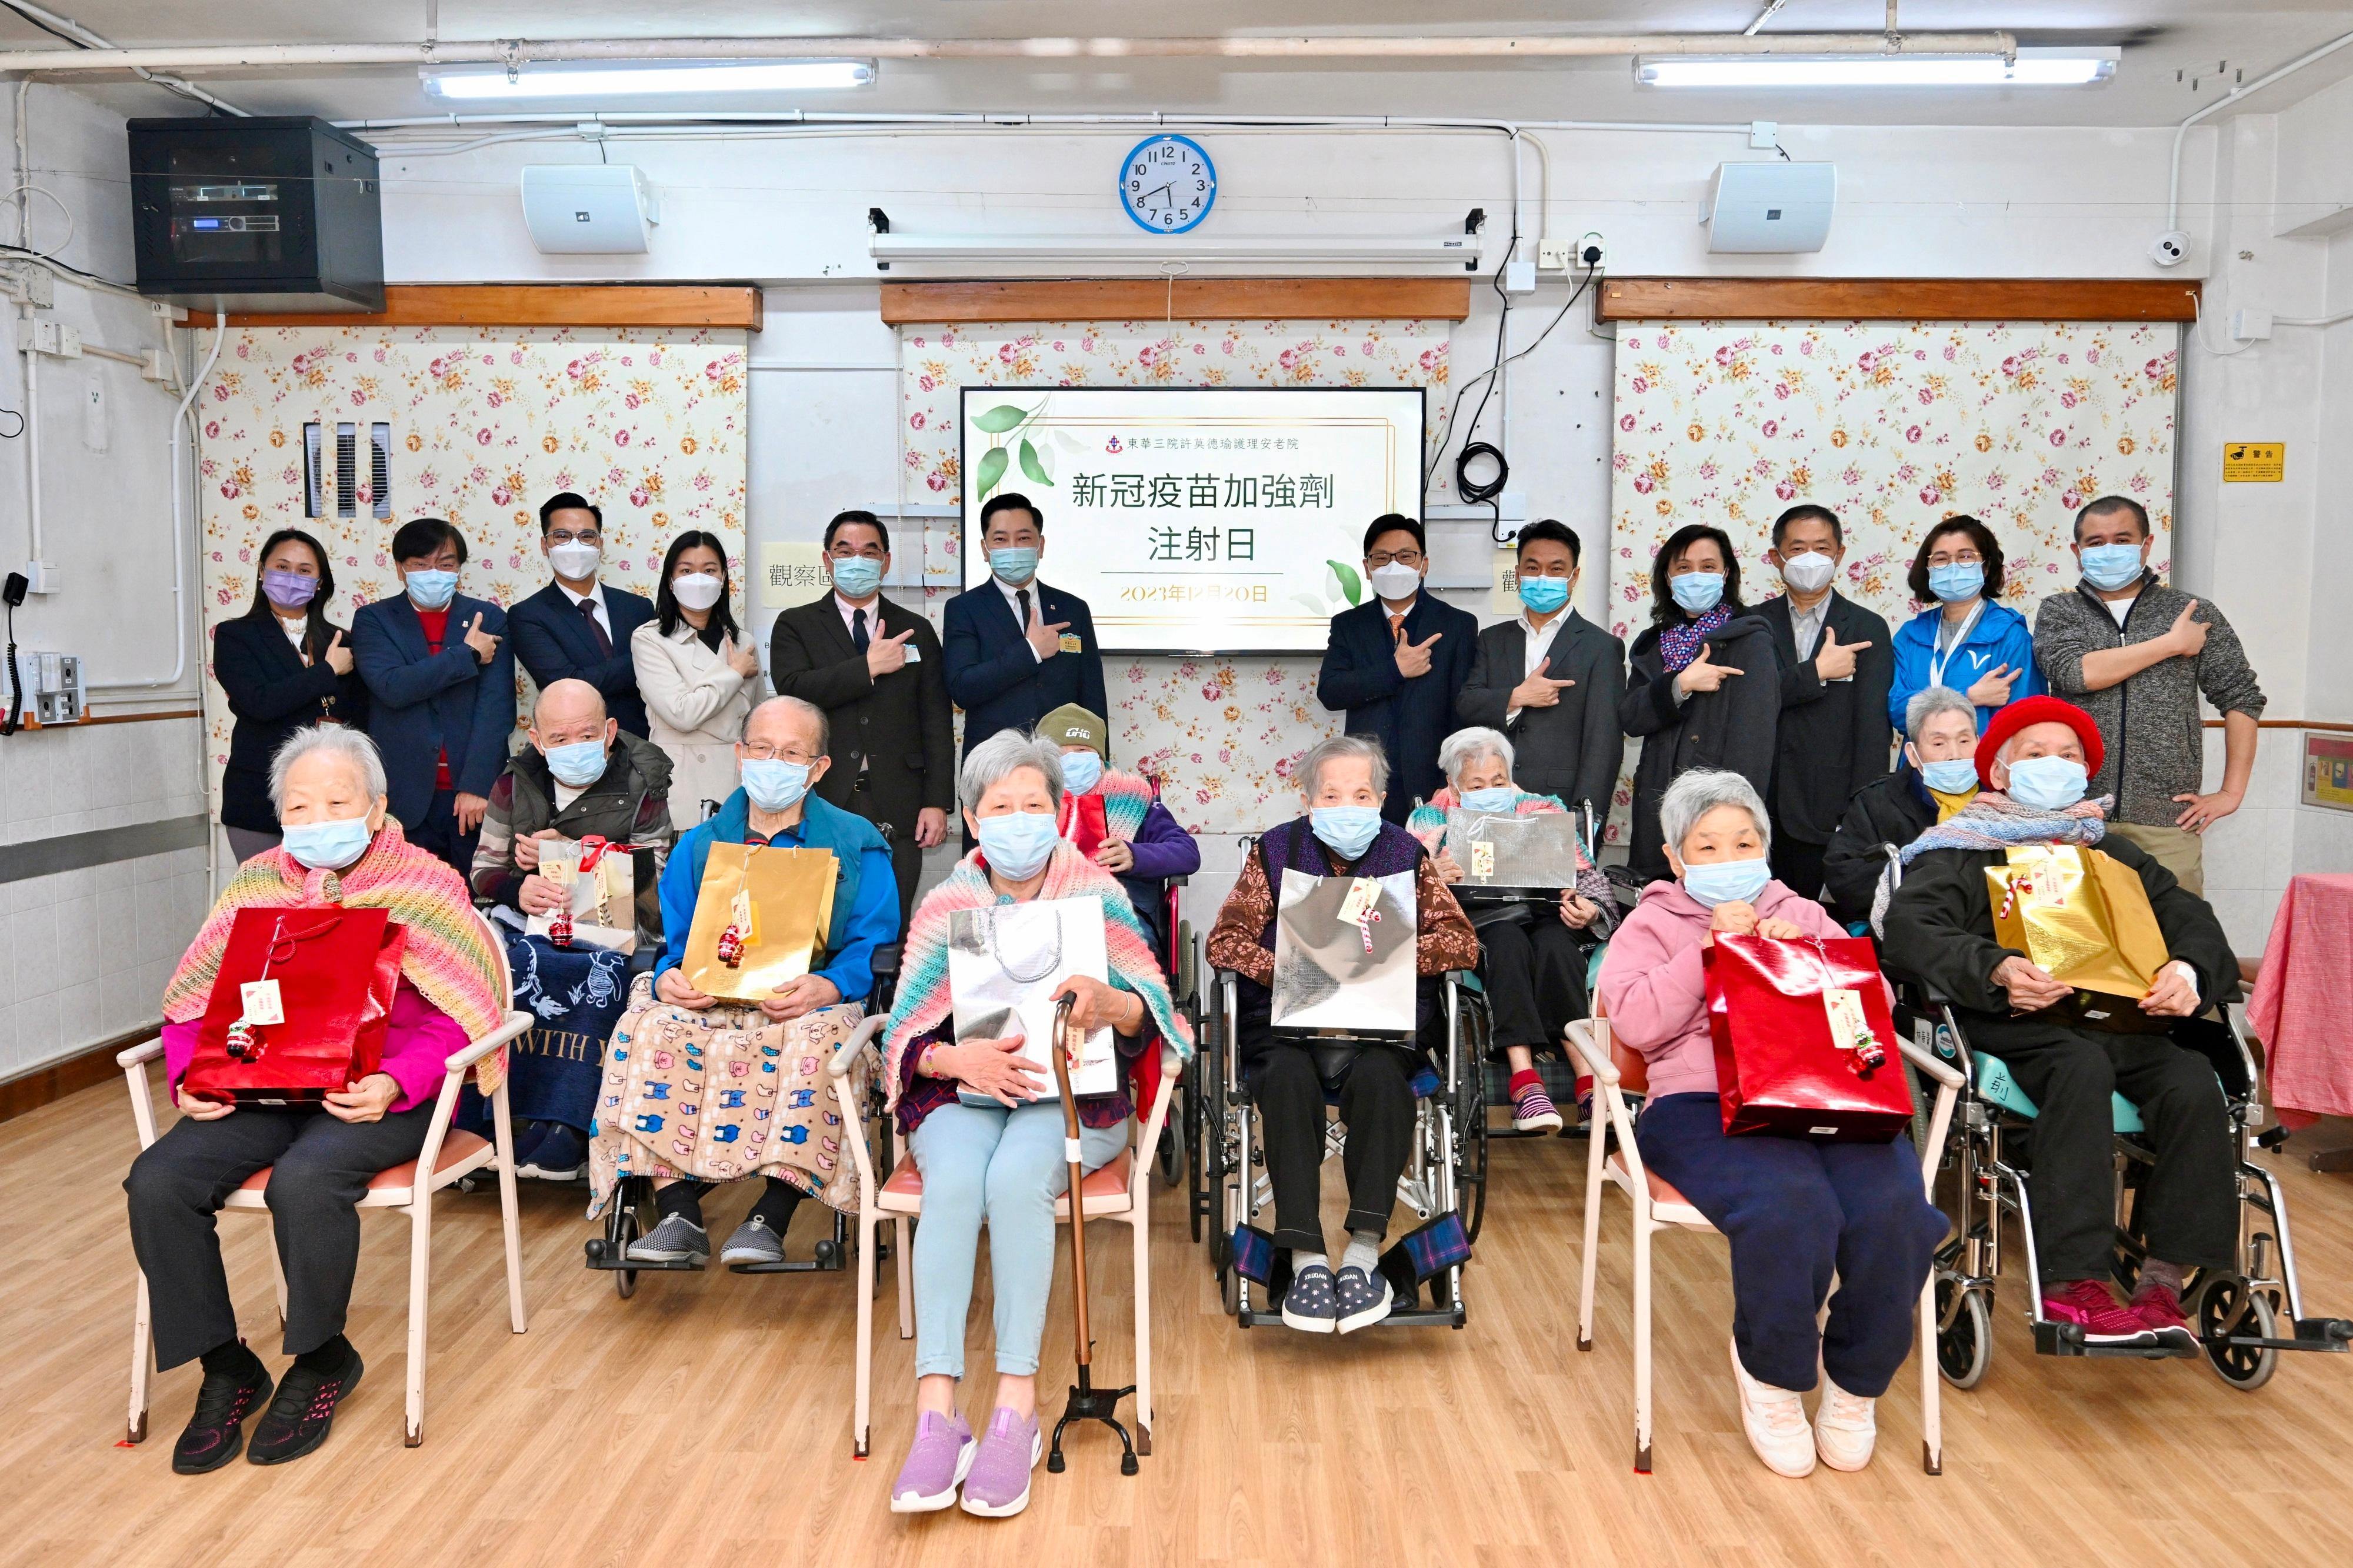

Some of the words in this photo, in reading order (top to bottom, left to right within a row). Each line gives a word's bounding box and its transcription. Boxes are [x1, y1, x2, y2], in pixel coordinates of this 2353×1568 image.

[1148, 151, 1157, 163] 11
[1162, 146, 1174, 158] 12
[1182, 151, 1185, 162] 1
[1135, 164, 1146, 175] 10
[1191, 164, 1201, 175] 2
[1131, 180, 1140, 192] 9
[1197, 179, 1205, 191] 3
[1136, 196, 1145, 208] 8
[1191, 196, 1201, 208] 4
[1149, 209, 1157, 221] 7
[1164, 213, 1173, 225] 6
[1179, 209, 1188, 220] 5
[1126, 437, 1299, 450] 東華三院許莫德瑜護理安老院
[1072, 472, 1334, 508] 新冠疫苗加強劑
[1148, 526, 1254, 561] 注射日
[1121, 584, 1267, 603] 2023年12月20日
[515, 1028, 590, 1062] WITH
[1304, 1273, 1327, 1281] XIUXIAN
